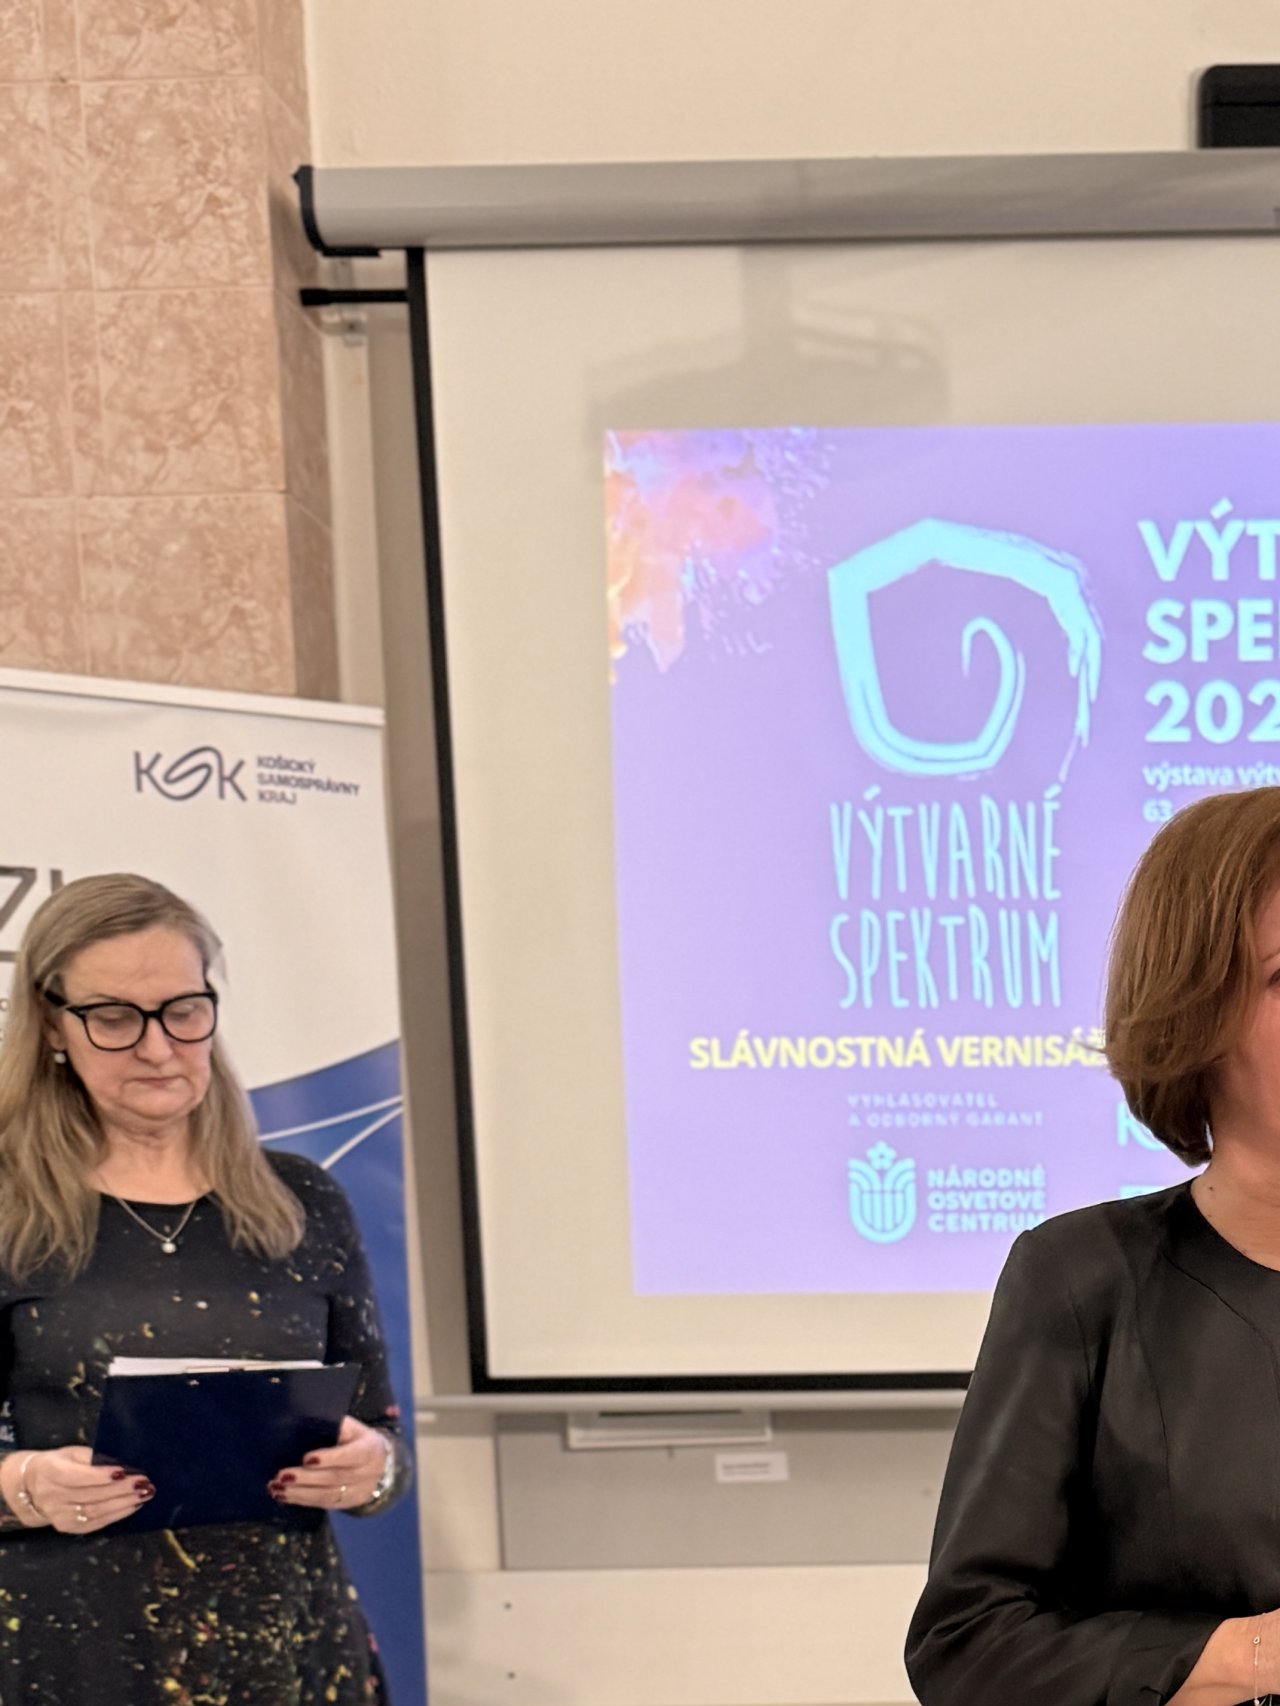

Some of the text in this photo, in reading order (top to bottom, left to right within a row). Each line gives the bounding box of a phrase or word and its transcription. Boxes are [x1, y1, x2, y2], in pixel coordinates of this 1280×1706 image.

[258, 789, 297, 805] KRAJ
[1142, 761, 1233, 792] výstava
[829, 784, 1062, 900] VÝTVARNÉ
[829, 903, 1062, 1009] SPEKTRUM
[689, 1027, 932, 1070] SLÁVNOSTNÁ
